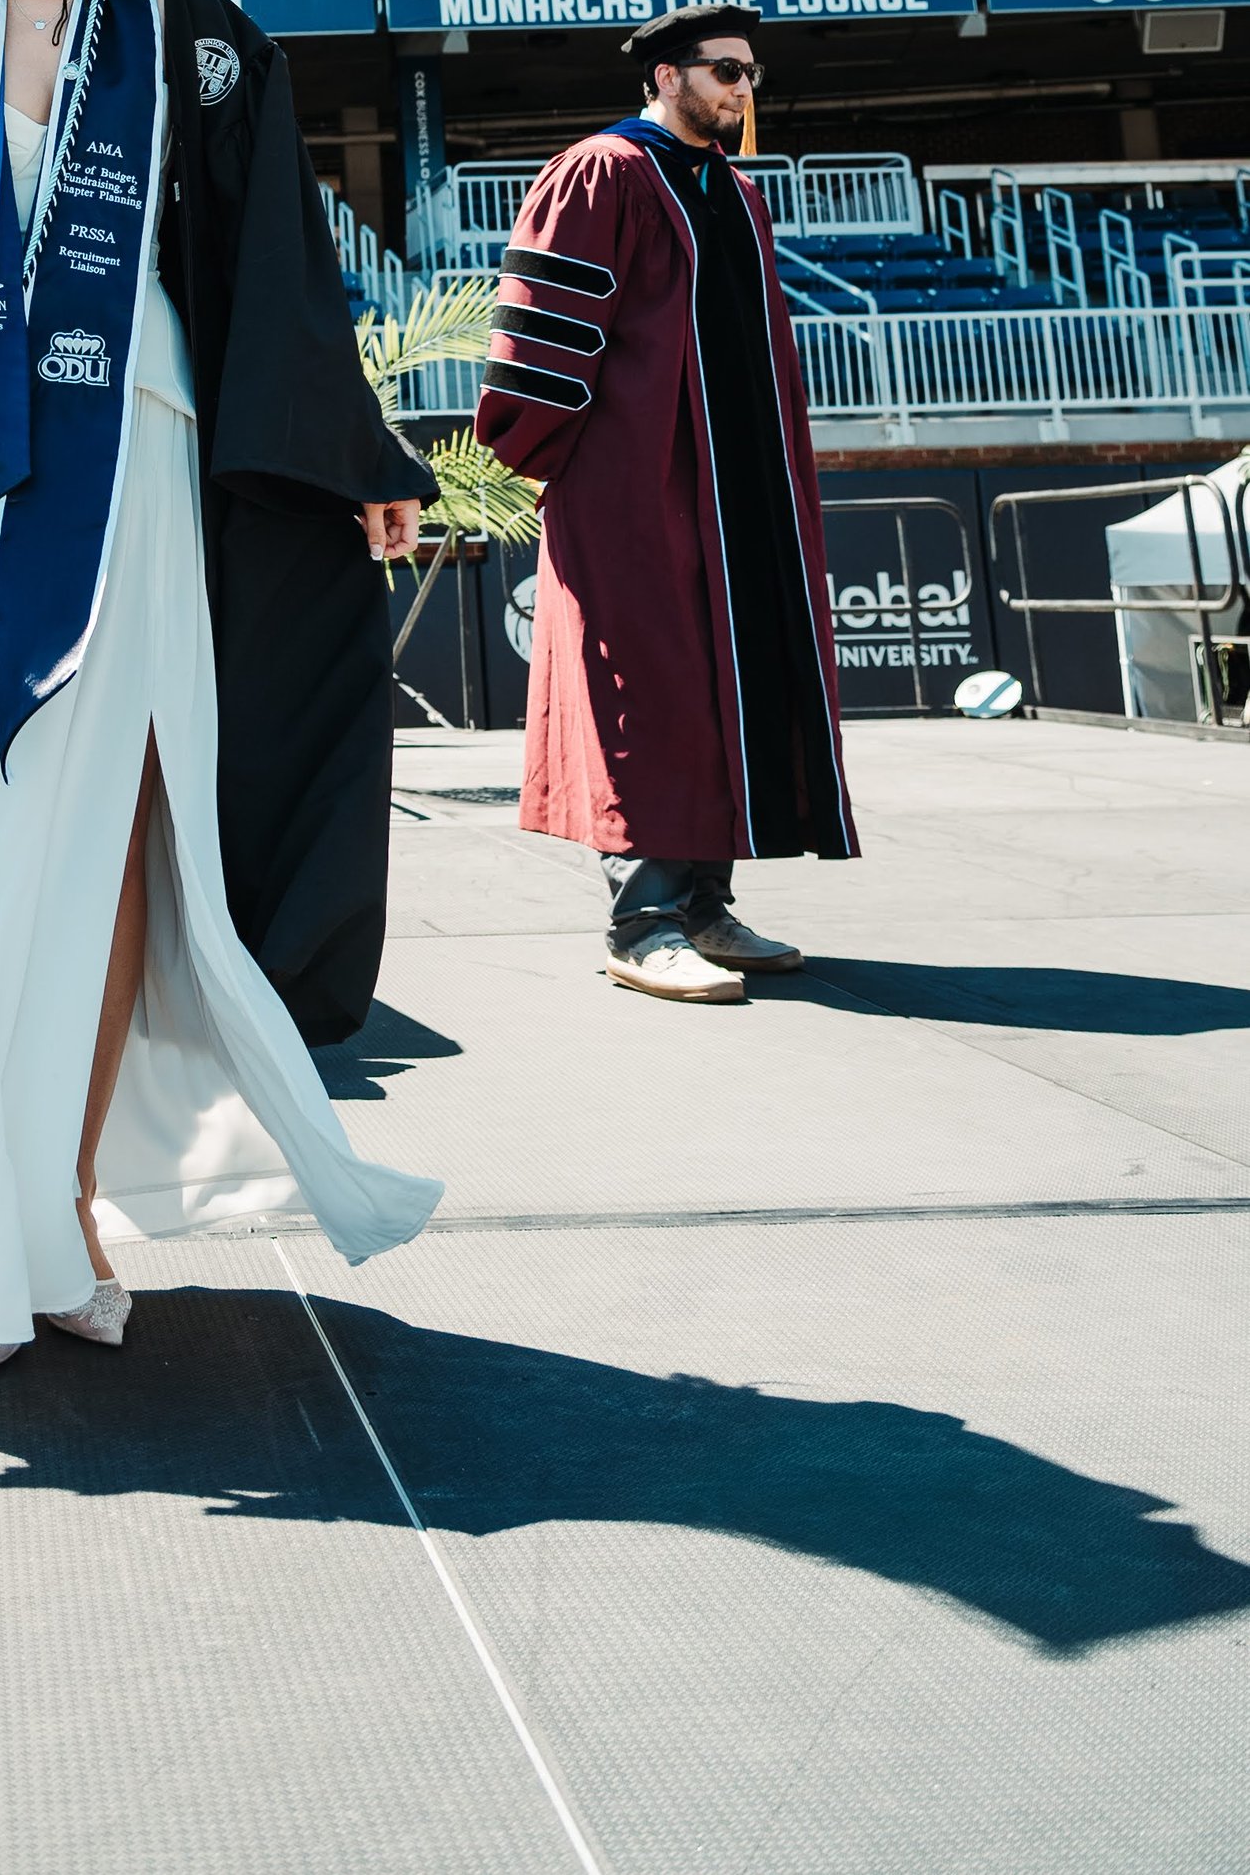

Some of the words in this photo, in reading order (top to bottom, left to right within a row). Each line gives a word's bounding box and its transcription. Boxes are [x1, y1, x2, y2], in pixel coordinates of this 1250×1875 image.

[415, 71, 426, 97] COX
[86, 141, 123, 158] AMA
[64, 172, 123, 194] Fundraising,
[127, 185, 138, 195] &
[68, 162, 82, 172] VP
[84, 165, 97, 175] of
[100, 167, 138, 185] Budget,
[62, 183, 95, 198] hapter
[99, 190, 143, 209] Planning
[69, 224, 116, 244] PRSSA
[59, 245, 121, 266] Recruitment
[70, 259, 106, 275] Liaison
[41, 355, 108, 384] ODU
[826, 570, 971, 628] lobal
